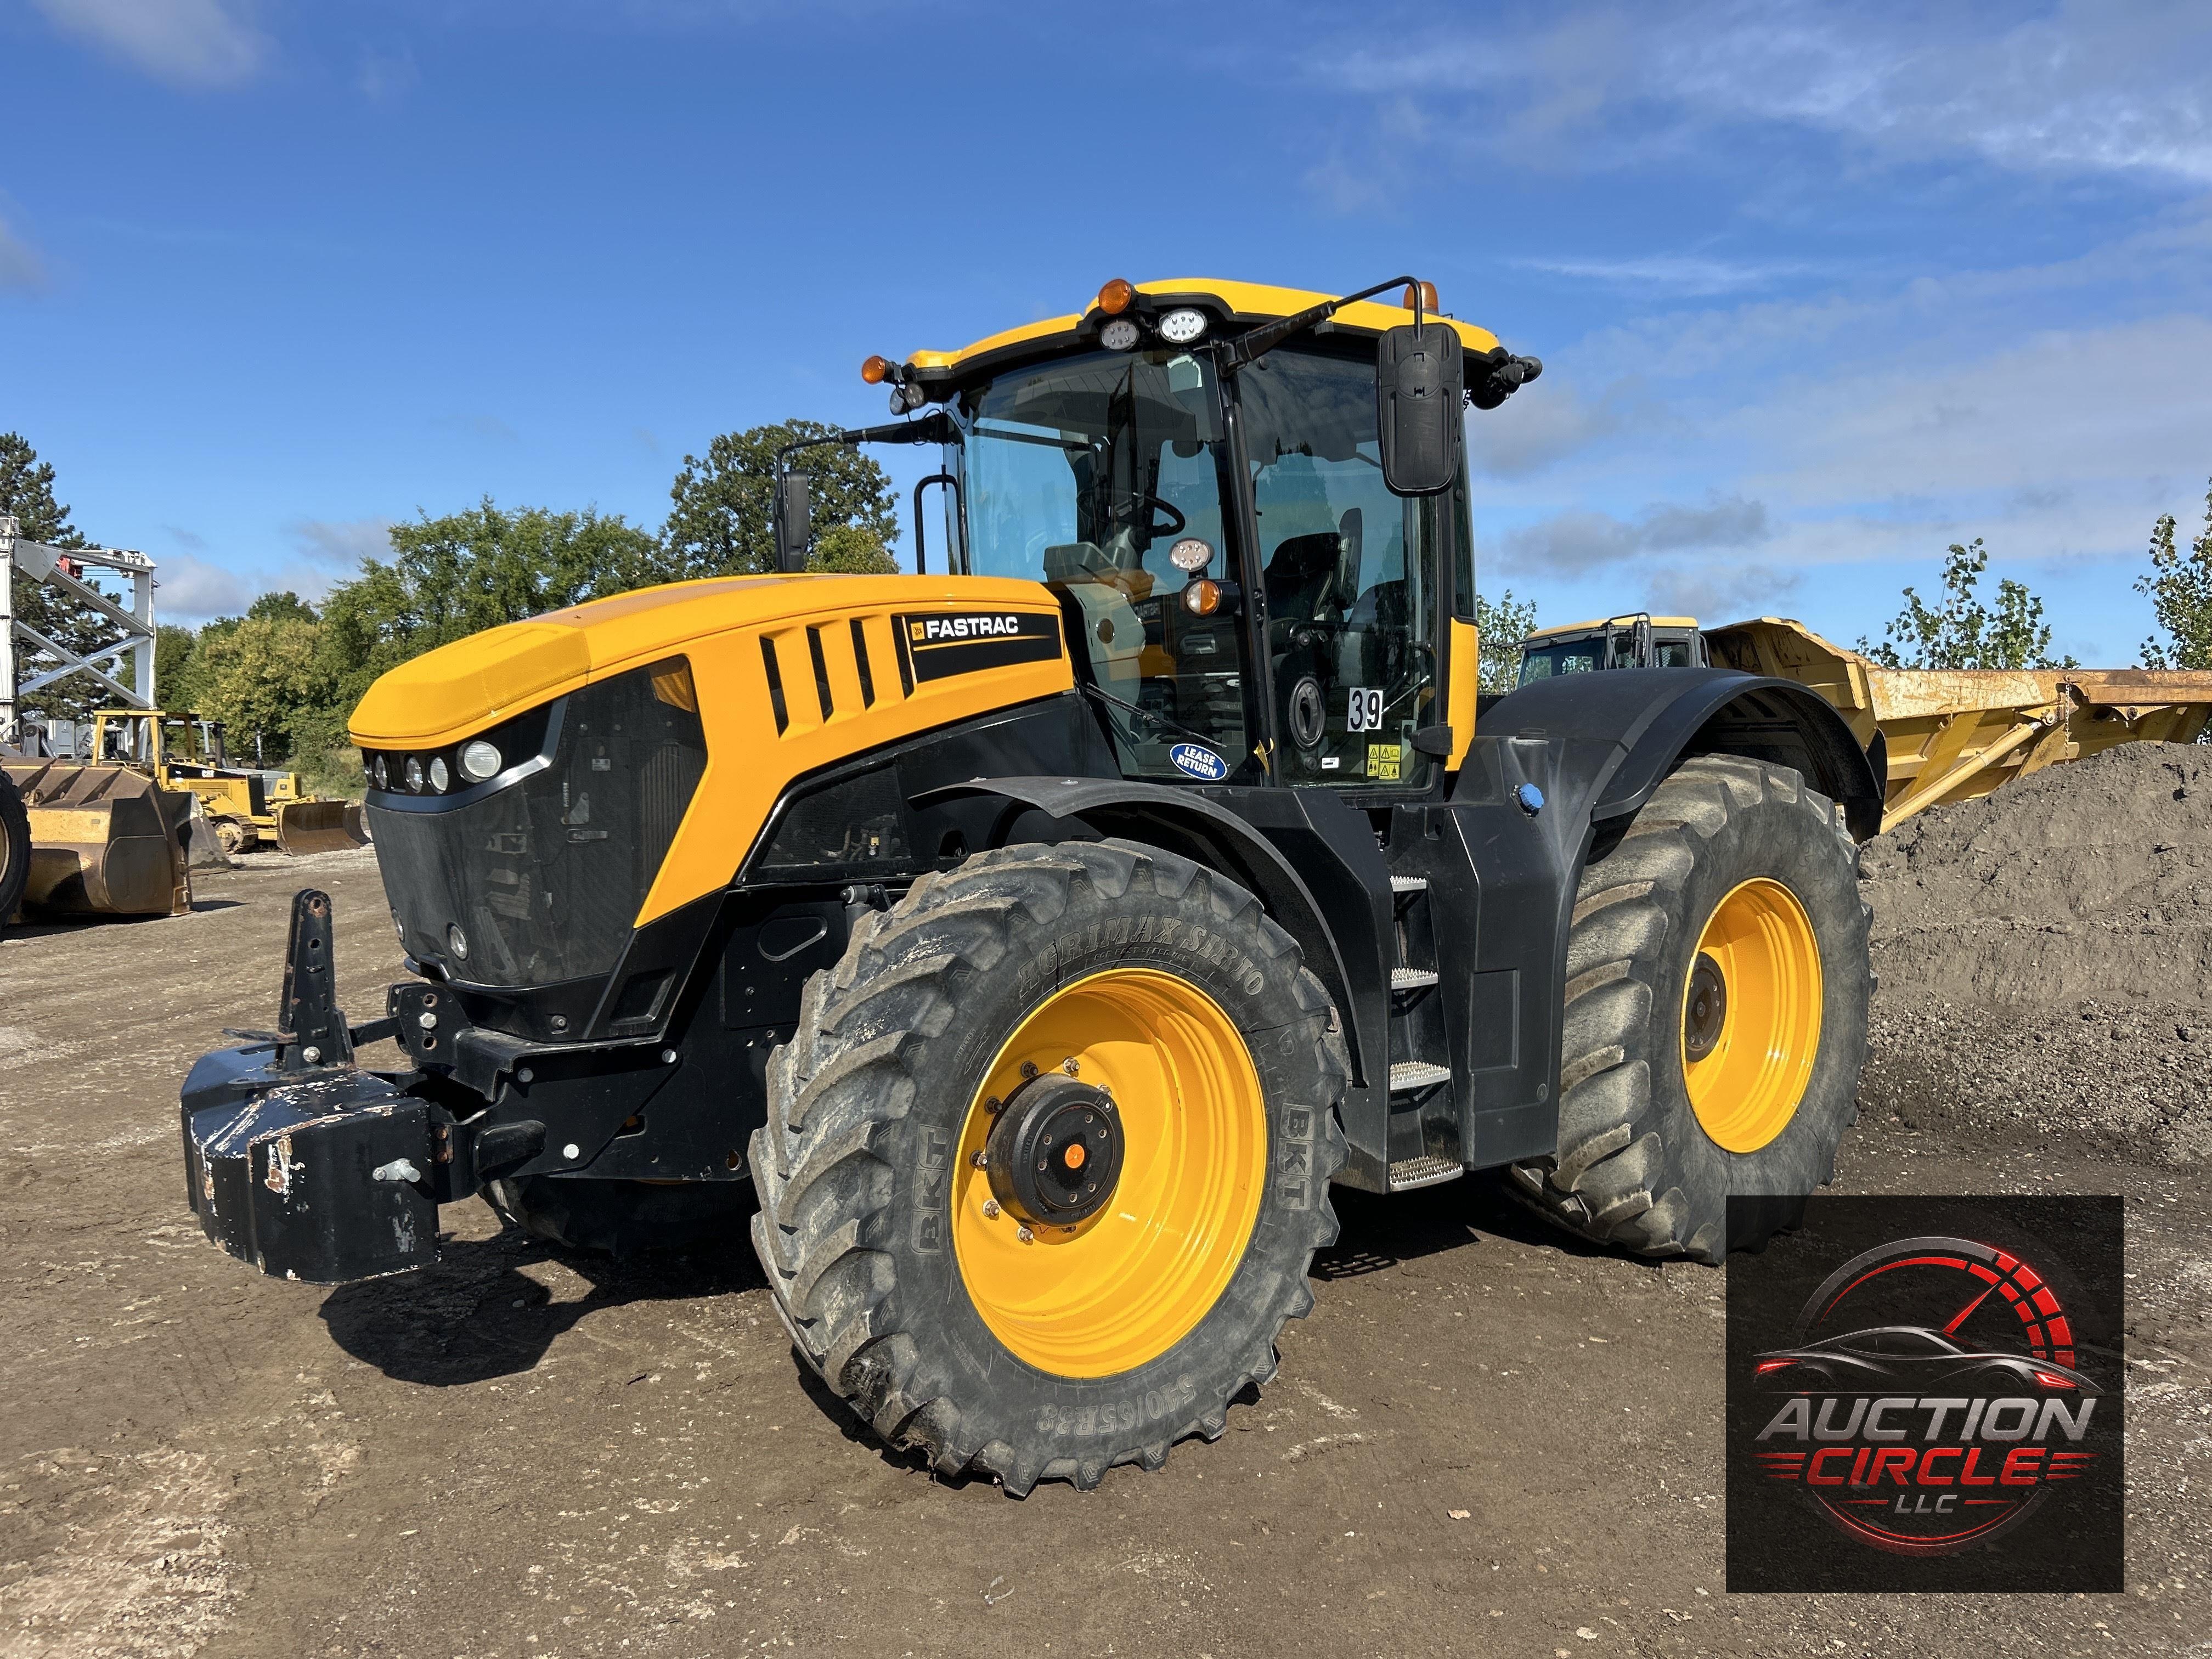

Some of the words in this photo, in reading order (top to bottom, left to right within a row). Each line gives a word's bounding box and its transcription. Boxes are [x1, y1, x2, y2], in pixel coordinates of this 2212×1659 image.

[926, 617, 1018, 639] FASTRAC
[1350, 690, 1380, 730] 39
[1177, 754, 1217, 778] RETURN
[1184, 746, 1216, 766] LEASE
[1019, 916, 1182, 1000] AGRIMAX
[1181, 925, 1265, 996] SIRIO
[1284, 1108, 1310, 1207] BKT
[919, 1131, 947, 1249] BKT
[1037, 1373, 1196, 1437] 540/65R38
